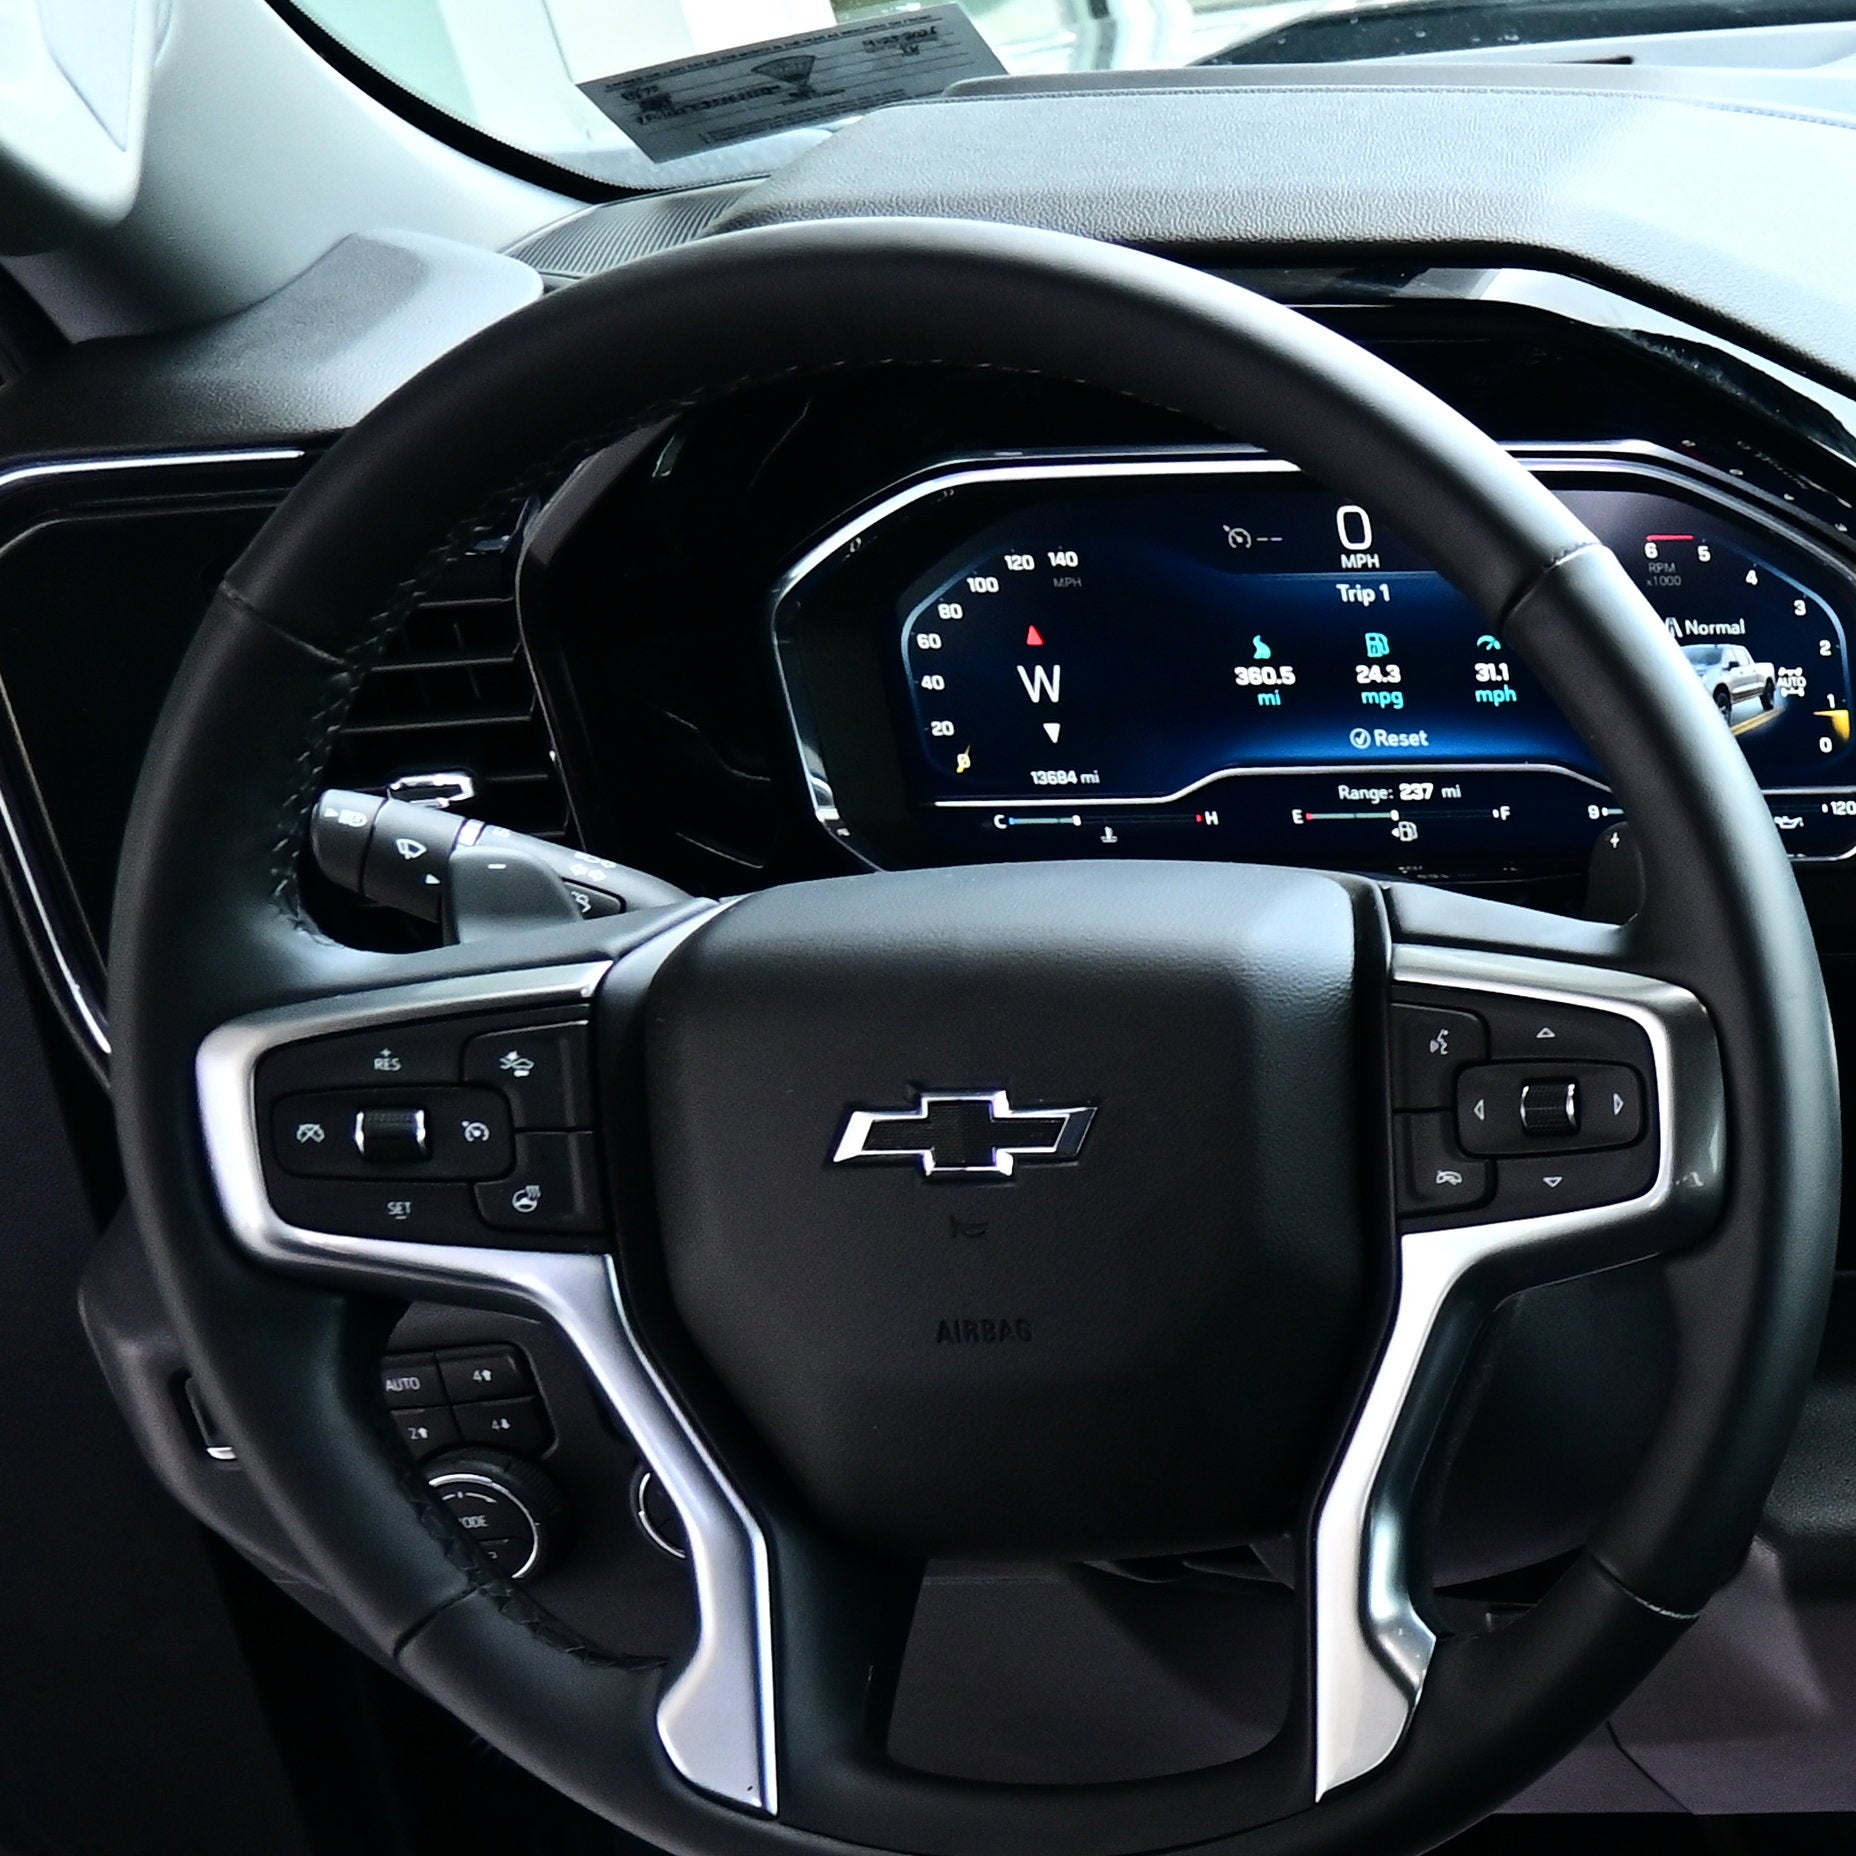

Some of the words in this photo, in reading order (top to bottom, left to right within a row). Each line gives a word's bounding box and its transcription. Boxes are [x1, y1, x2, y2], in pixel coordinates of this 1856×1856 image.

[1336, 504, 1373, 551] 0
[1047, 550, 1079, 568] 140
[1644, 542, 1658, 559] 6
[1697, 545, 1711, 562] 5
[1003, 554, 1035, 571] 120
[1340, 553, 1381, 569] MPH
[1647, 561, 1677, 575] RPM
[966, 576, 1000, 593] 100
[1053, 576, 1083, 589] MPH
[1645, 574, 1683, 588] x1000
[1745, 569, 1759, 586] 4
[1335, 583, 1376, 607] Trip
[1378, 582, 1391, 602] 1
[937, 602, 963, 620] 80
[1793, 599, 1807, 616] 3
[1684, 617, 1746, 638] Normal
[916, 633, 942, 650] 60
[1819, 639, 1832, 657] 2
[1233, 665, 1296, 686] 360.5
[1355, 664, 1402, 684] 24.3
[1474, 662, 1510, 683] 31.1
[920, 674, 945, 691] 40
[1016, 664, 1061, 704] W
[1257, 689, 1282, 706] mi
[1360, 690, 1404, 710] mpg
[1474, 685, 1518, 708] mph
[1825, 691, 1837, 711] 1
[930, 720, 955, 737] 20
[1371, 728, 1431, 750] Reset
[1819, 736, 1833, 754] 0
[1079, 769, 1101, 784] mi
[1337, 784, 1394, 805] Range:
[1398, 782, 1434, 801] 237
[1440, 783, 1462, 799] mi
[1204, 810, 1219, 826] H
[1291, 808, 1305, 825] E
[1499, 805, 1511, 821] F
[993, 814, 1008, 830] C
[373, 1057, 402, 1071] RES
[385, 1200, 412, 1216] SET
[936, 1320, 1032, 1343] AIRBAG
[384, 1376, 421, 1392] AUTO
[458, 1514, 489, 1528] ODE
